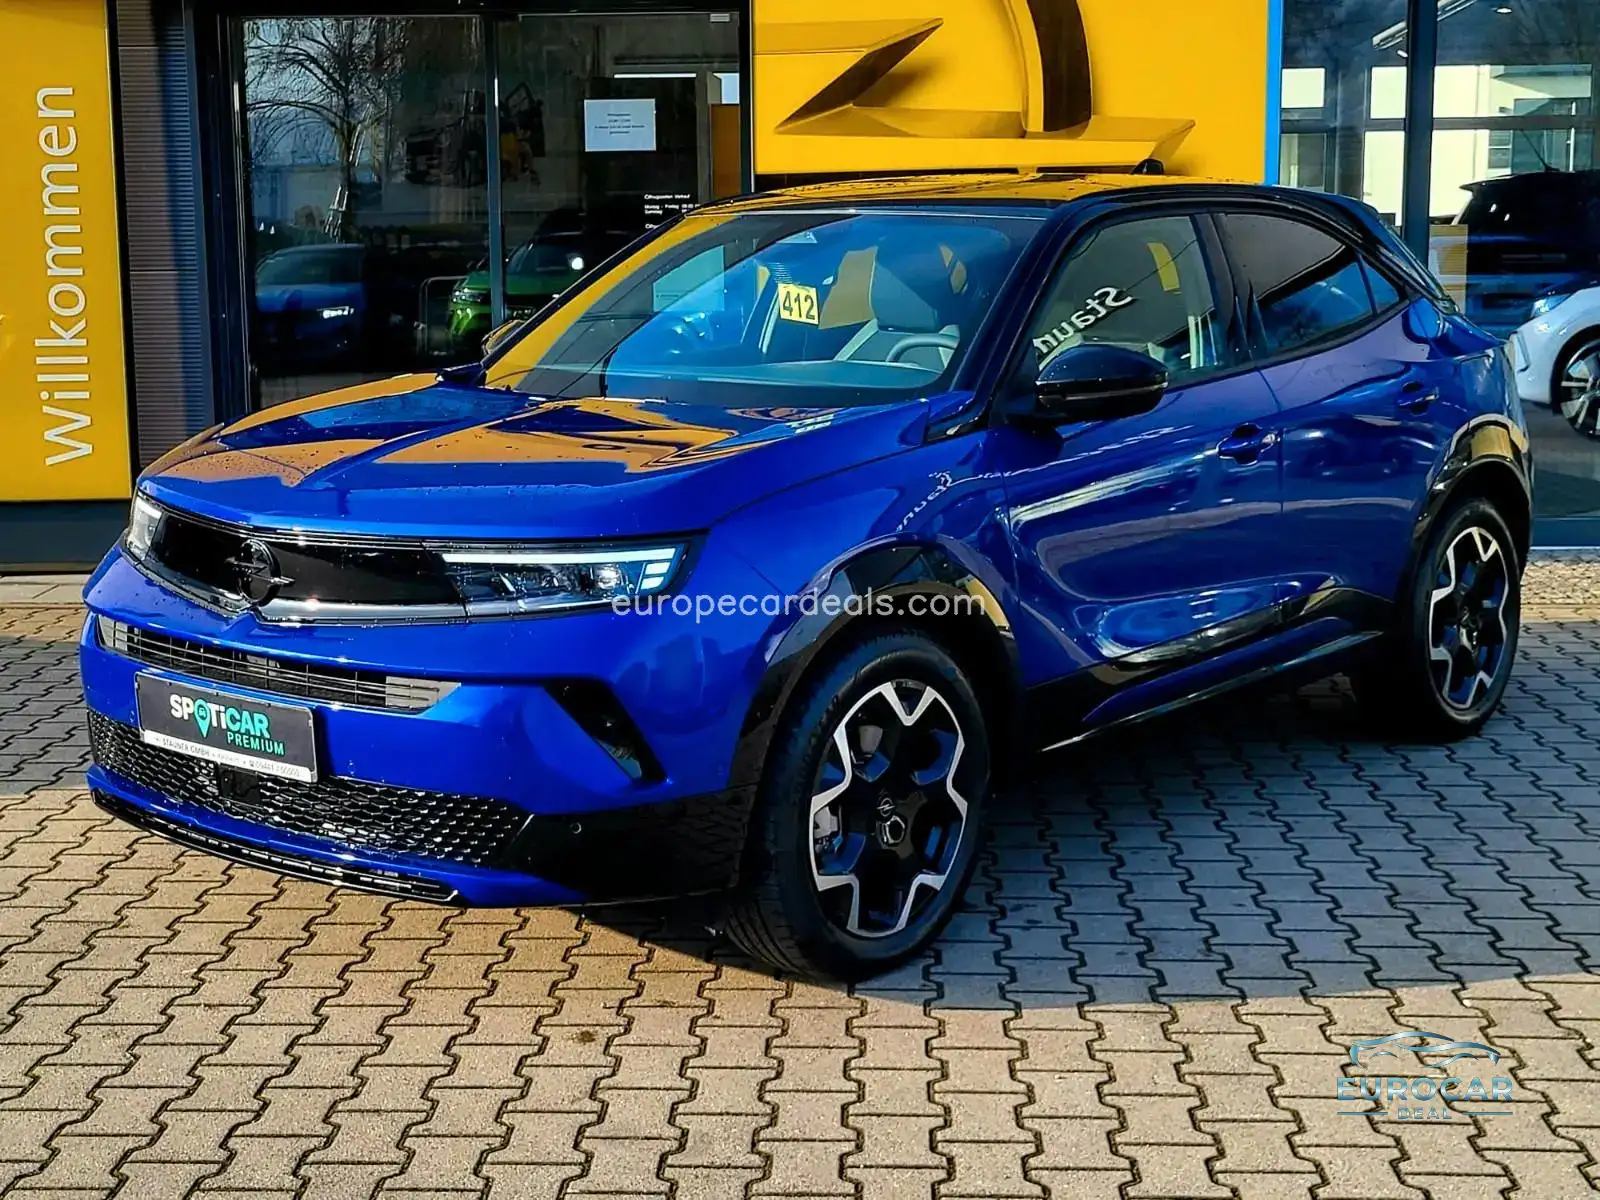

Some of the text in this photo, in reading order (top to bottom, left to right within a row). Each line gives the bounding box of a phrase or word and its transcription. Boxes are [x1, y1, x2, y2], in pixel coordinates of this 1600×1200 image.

[34, 86, 94, 466] Willkommen
[782, 290, 816, 321] 412
[227, 731, 285, 756] PREMIUM
